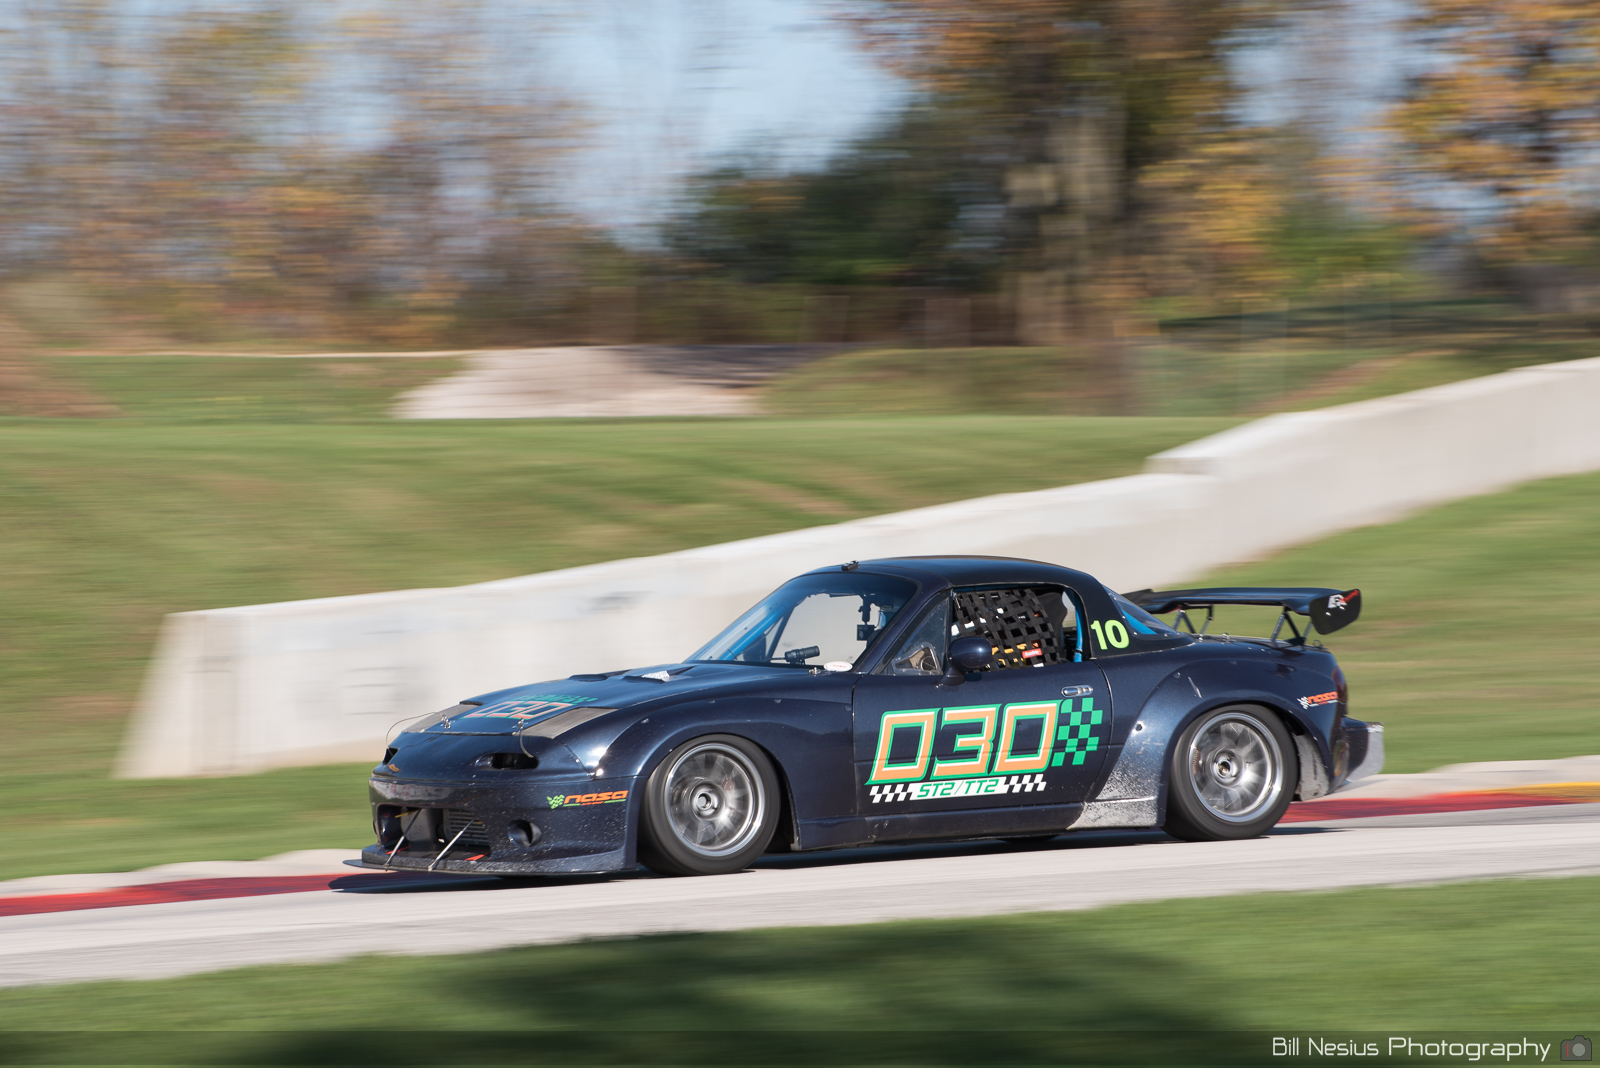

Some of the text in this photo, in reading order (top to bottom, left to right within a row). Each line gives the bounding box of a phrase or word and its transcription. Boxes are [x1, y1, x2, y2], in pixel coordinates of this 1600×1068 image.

[1090, 619, 1130, 650] 10
[865, 699, 1063, 785] 030
[916, 778, 1000, 798] ST2/TT2
